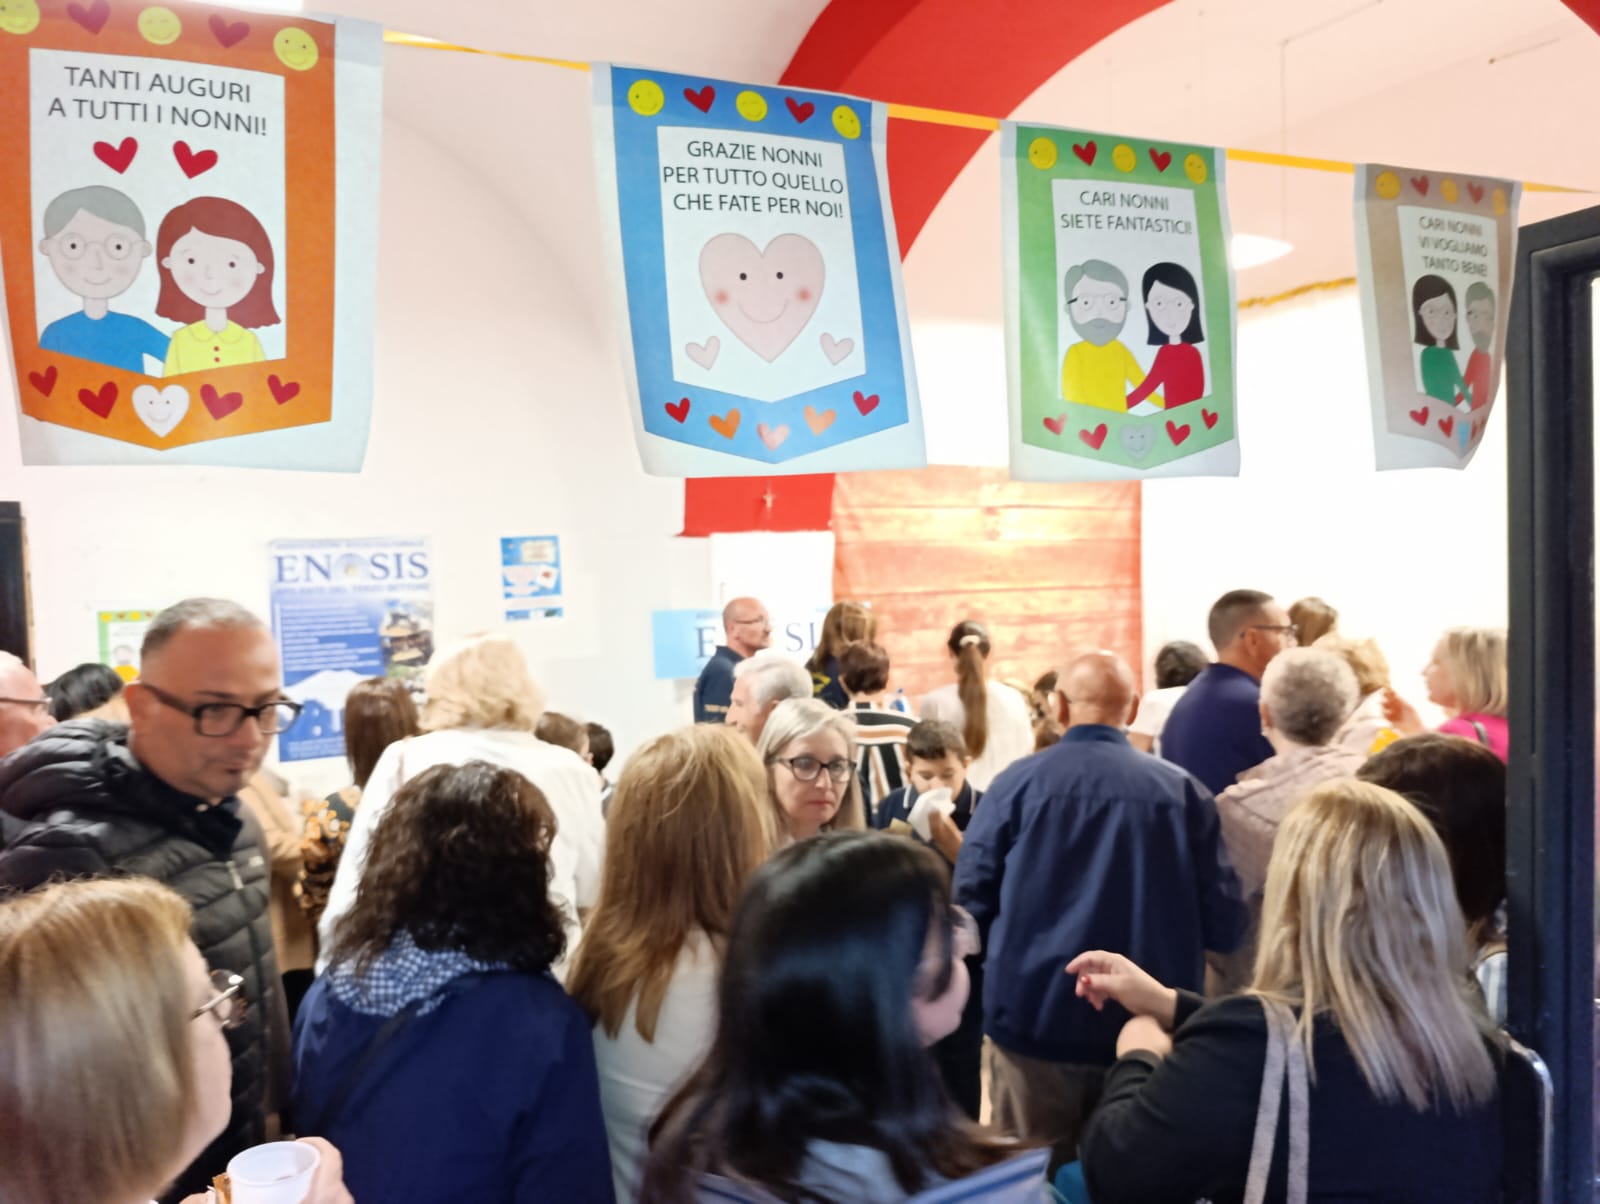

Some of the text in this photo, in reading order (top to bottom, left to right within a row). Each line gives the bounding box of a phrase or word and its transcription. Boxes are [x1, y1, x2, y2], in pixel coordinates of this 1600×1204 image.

[64, 66, 252, 103] TANTI AUGURI
[48, 98, 267, 136] A TUTTI I NONNI!
[687, 140, 823, 168] GRAZIE NONNI
[663, 166, 844, 194] PER TUTTO QUELLO
[673, 193, 844, 218] CHE FATE PER NOI!
[1079, 190, 1169, 211] CARI NONNI
[1060, 213, 1103, 230] SIETE
[1419, 216, 1483, 237] CARI NONNI
[1421, 255, 1460, 273] TANTO
